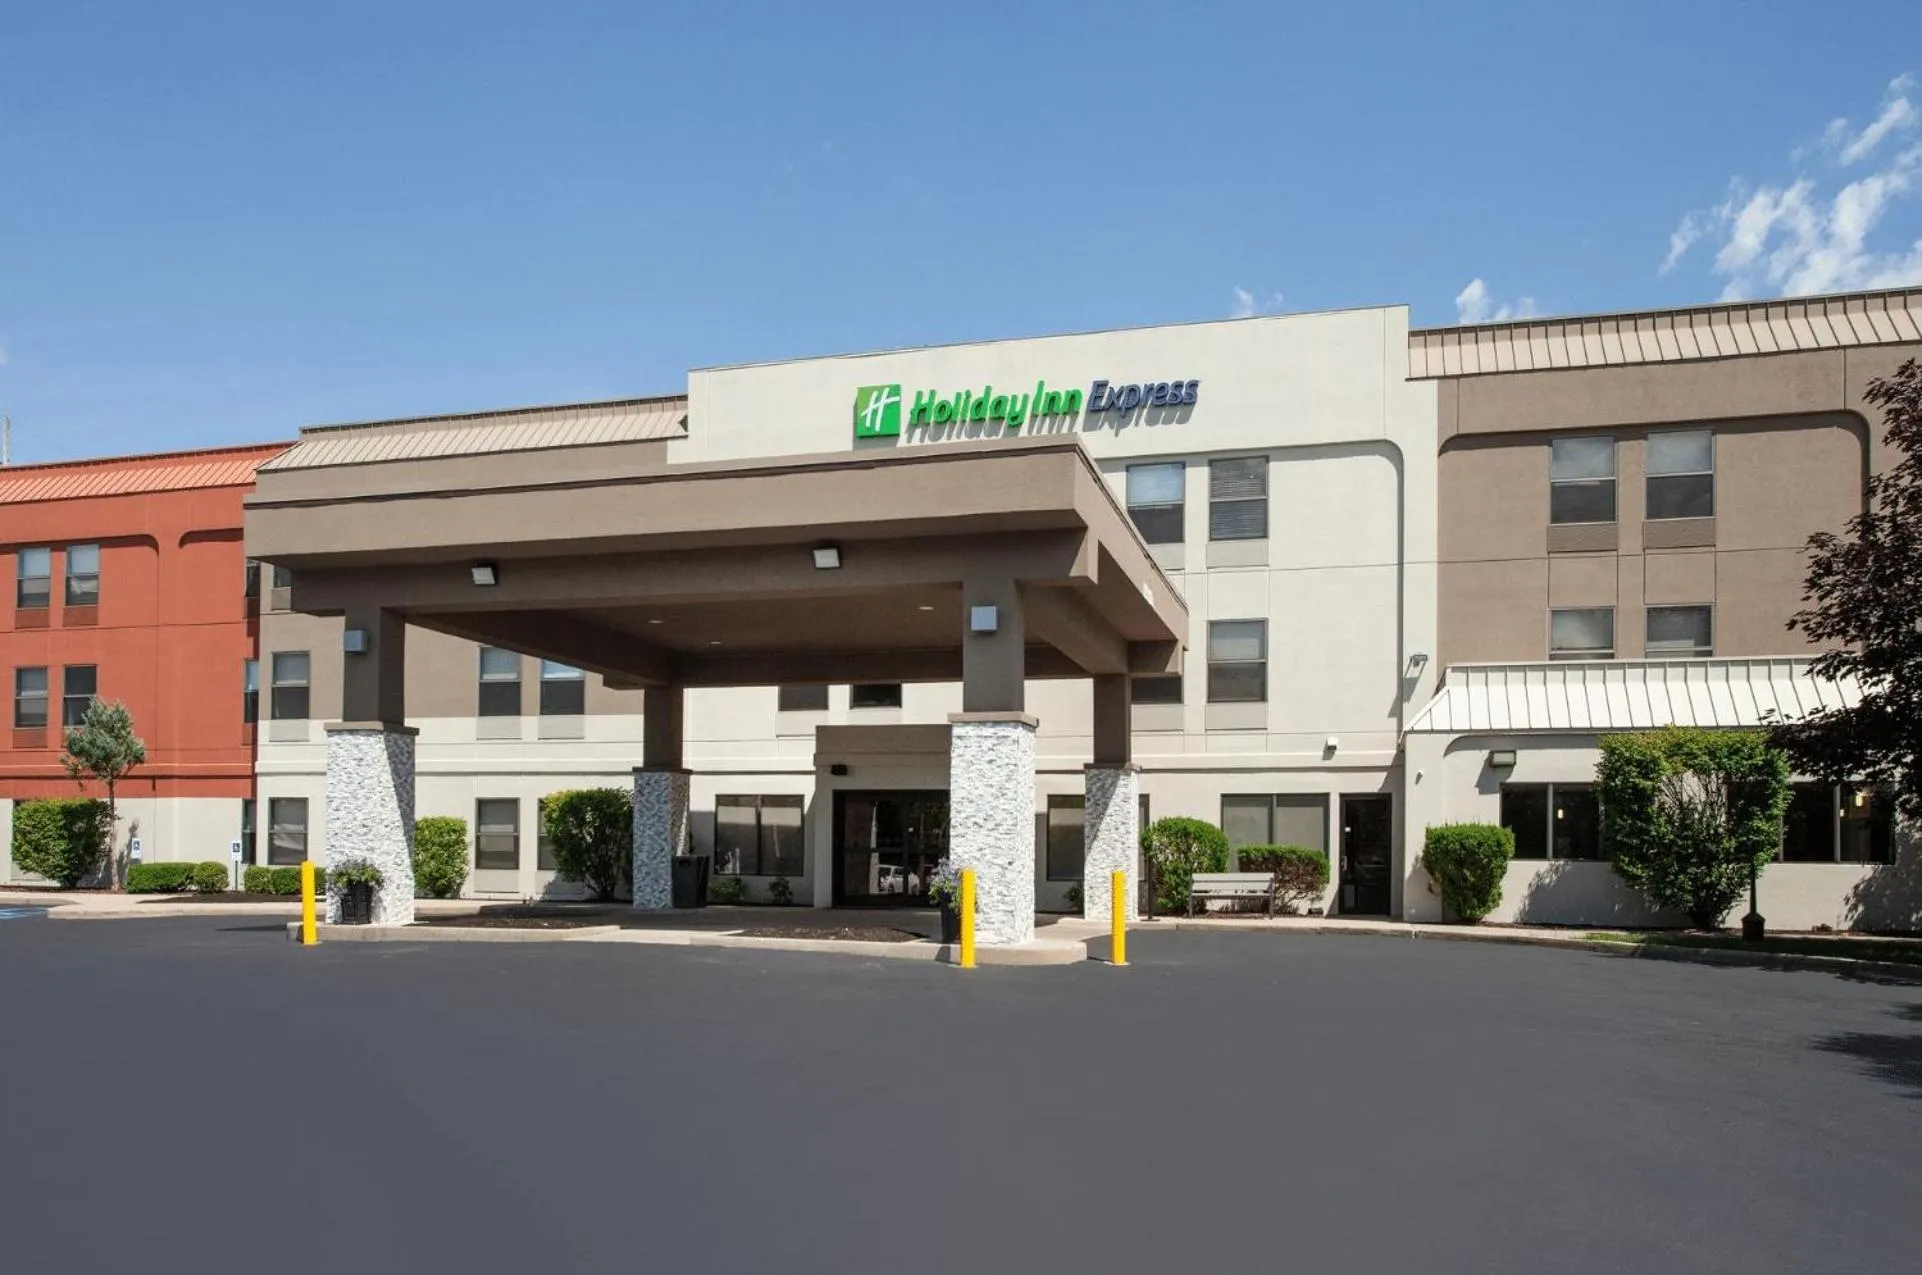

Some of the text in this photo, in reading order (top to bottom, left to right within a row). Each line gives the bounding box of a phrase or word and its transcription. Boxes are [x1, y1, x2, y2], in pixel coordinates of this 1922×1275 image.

[910, 379, 1200, 428] Holiday Inn Express
